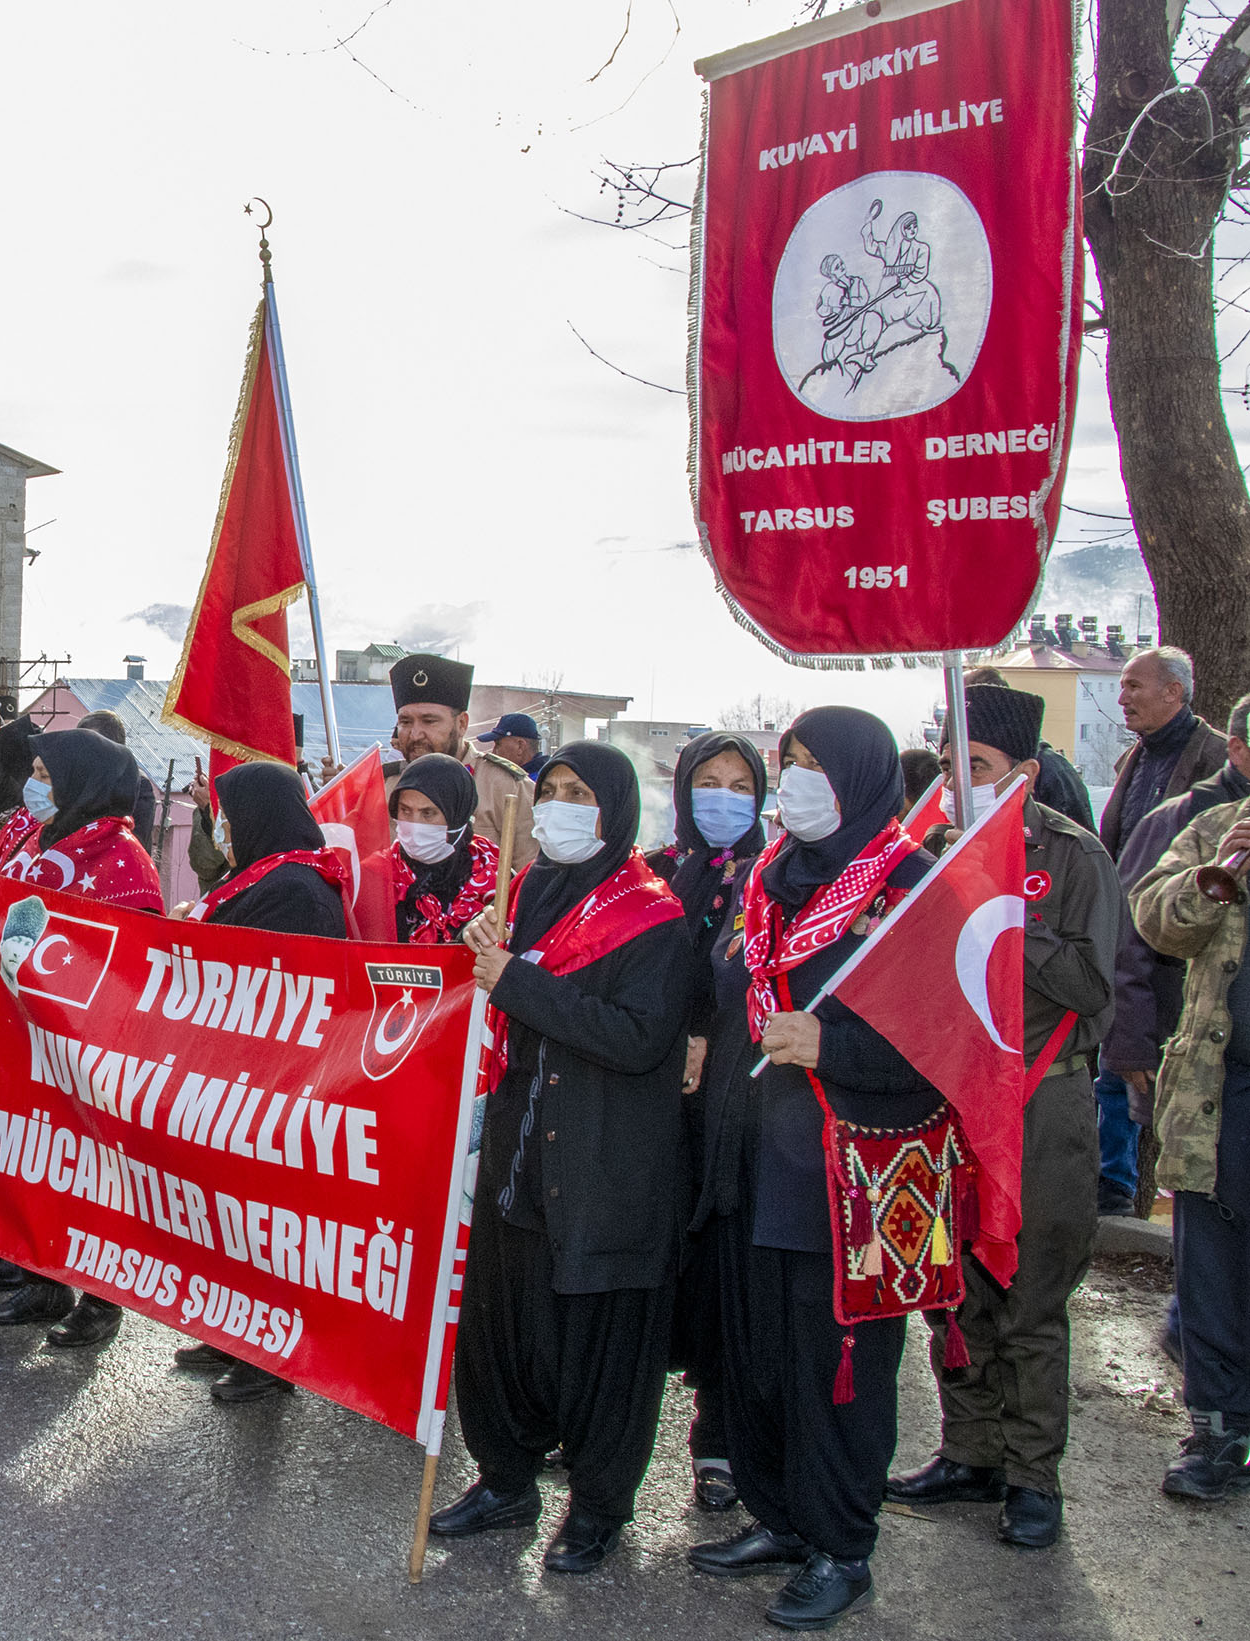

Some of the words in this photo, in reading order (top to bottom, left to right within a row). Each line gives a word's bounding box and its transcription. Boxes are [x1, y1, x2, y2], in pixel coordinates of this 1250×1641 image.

[822, 40, 939, 93] TÜRKİYE
[759, 122, 857, 171] KUVAYİ
[890, 99, 1004, 142] MİLLİYE
[722, 437, 892, 475] MÜCAHİTLER
[740, 505, 855, 534] TARSUS
[926, 490, 1038, 527] ŞUBESİ
[844, 565, 908, 589] 1951
[136, 943, 335, 1049] TÜRKİYE
[377, 967, 433, 983] TÜRKİYE
[27, 1021, 177, 1130] KUVAYİ
[166, 1071, 380, 1186] MİLLİYE
[214, 1191, 414, 1322] DERNEĞİ
[64, 1226, 183, 1308] TARSUS
[179, 1274, 304, 1360] ŞUBESİ
